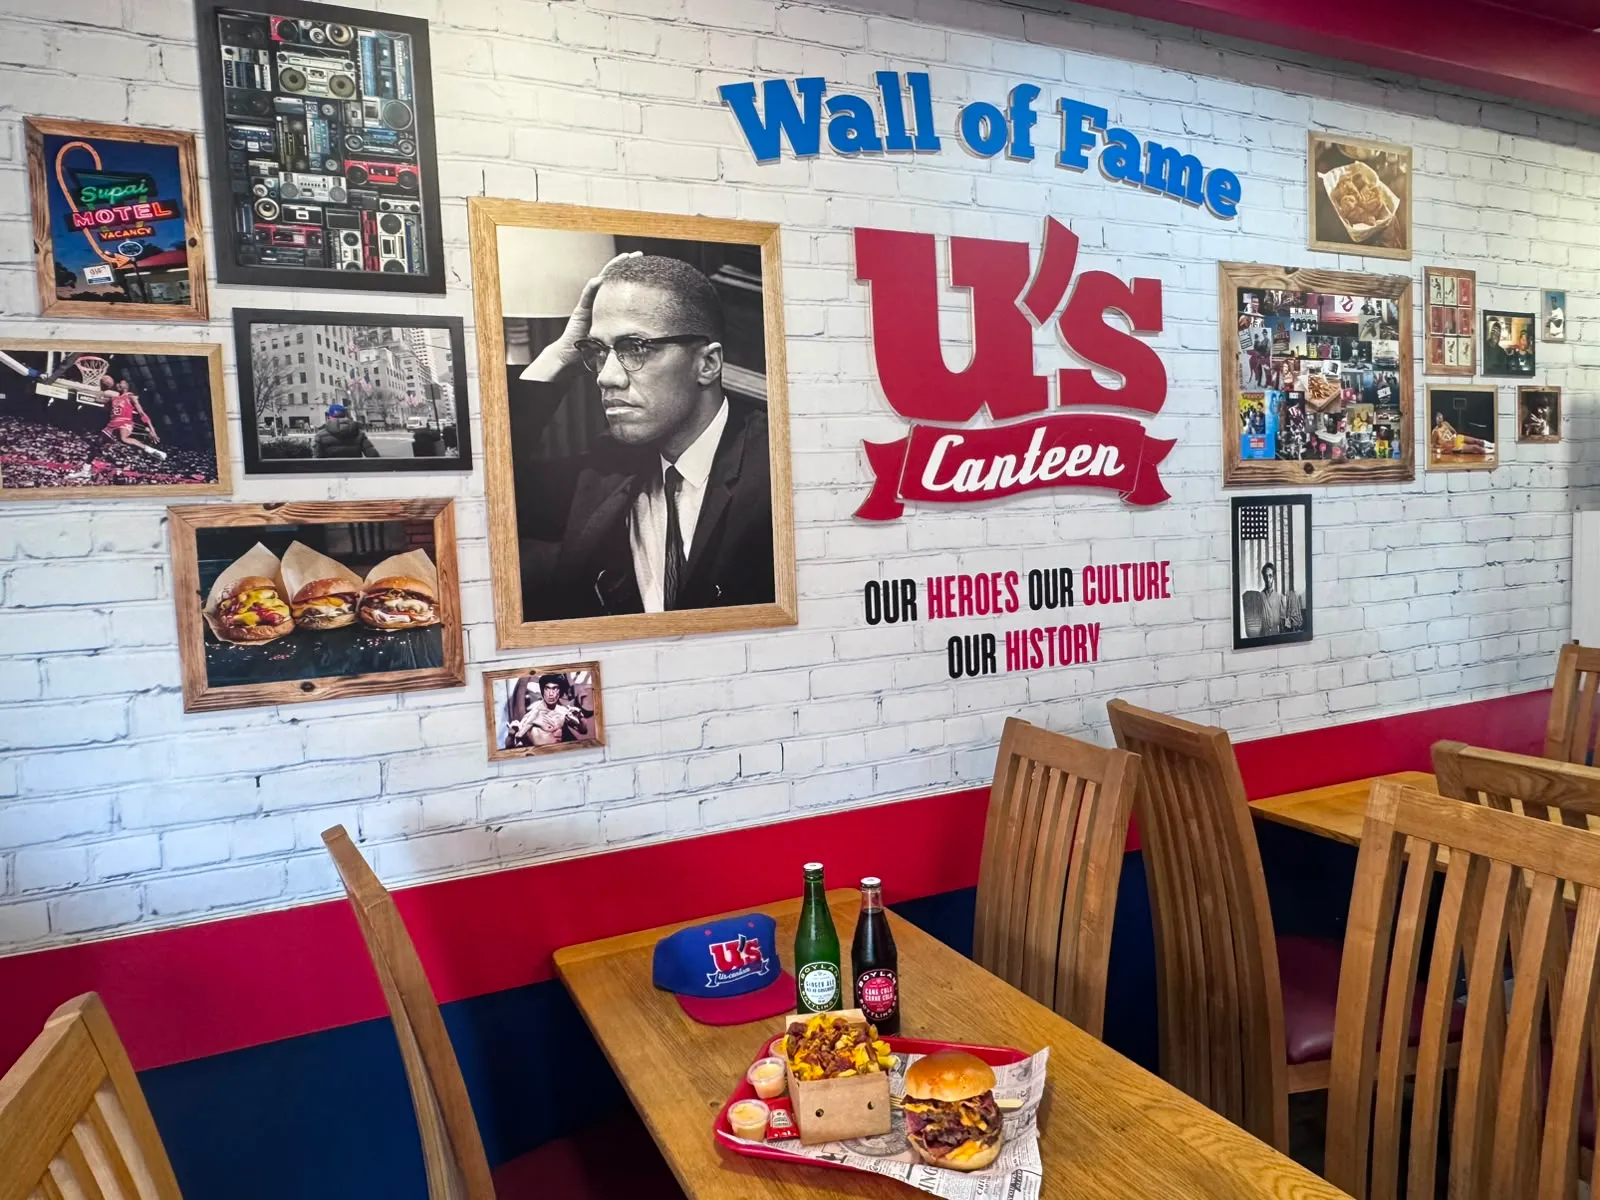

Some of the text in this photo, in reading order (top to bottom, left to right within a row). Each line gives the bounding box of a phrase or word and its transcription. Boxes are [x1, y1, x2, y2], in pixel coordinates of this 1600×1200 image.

[718, 71, 1242, 220] Wall of Fame
[80, 179, 149, 204] Supai
[73, 202, 173, 227] MOTEL
[100, 227, 152, 239] VACANCY
[920, 426, 1125, 494] Canteen
[864, 560, 1171, 626] OUR HEROES OUR CULTURE
[948, 622, 1101, 679] OUR HISTORY
[858, 971, 897, 988] BOYLAN
[859, 998, 893, 1019] BOTTLING
